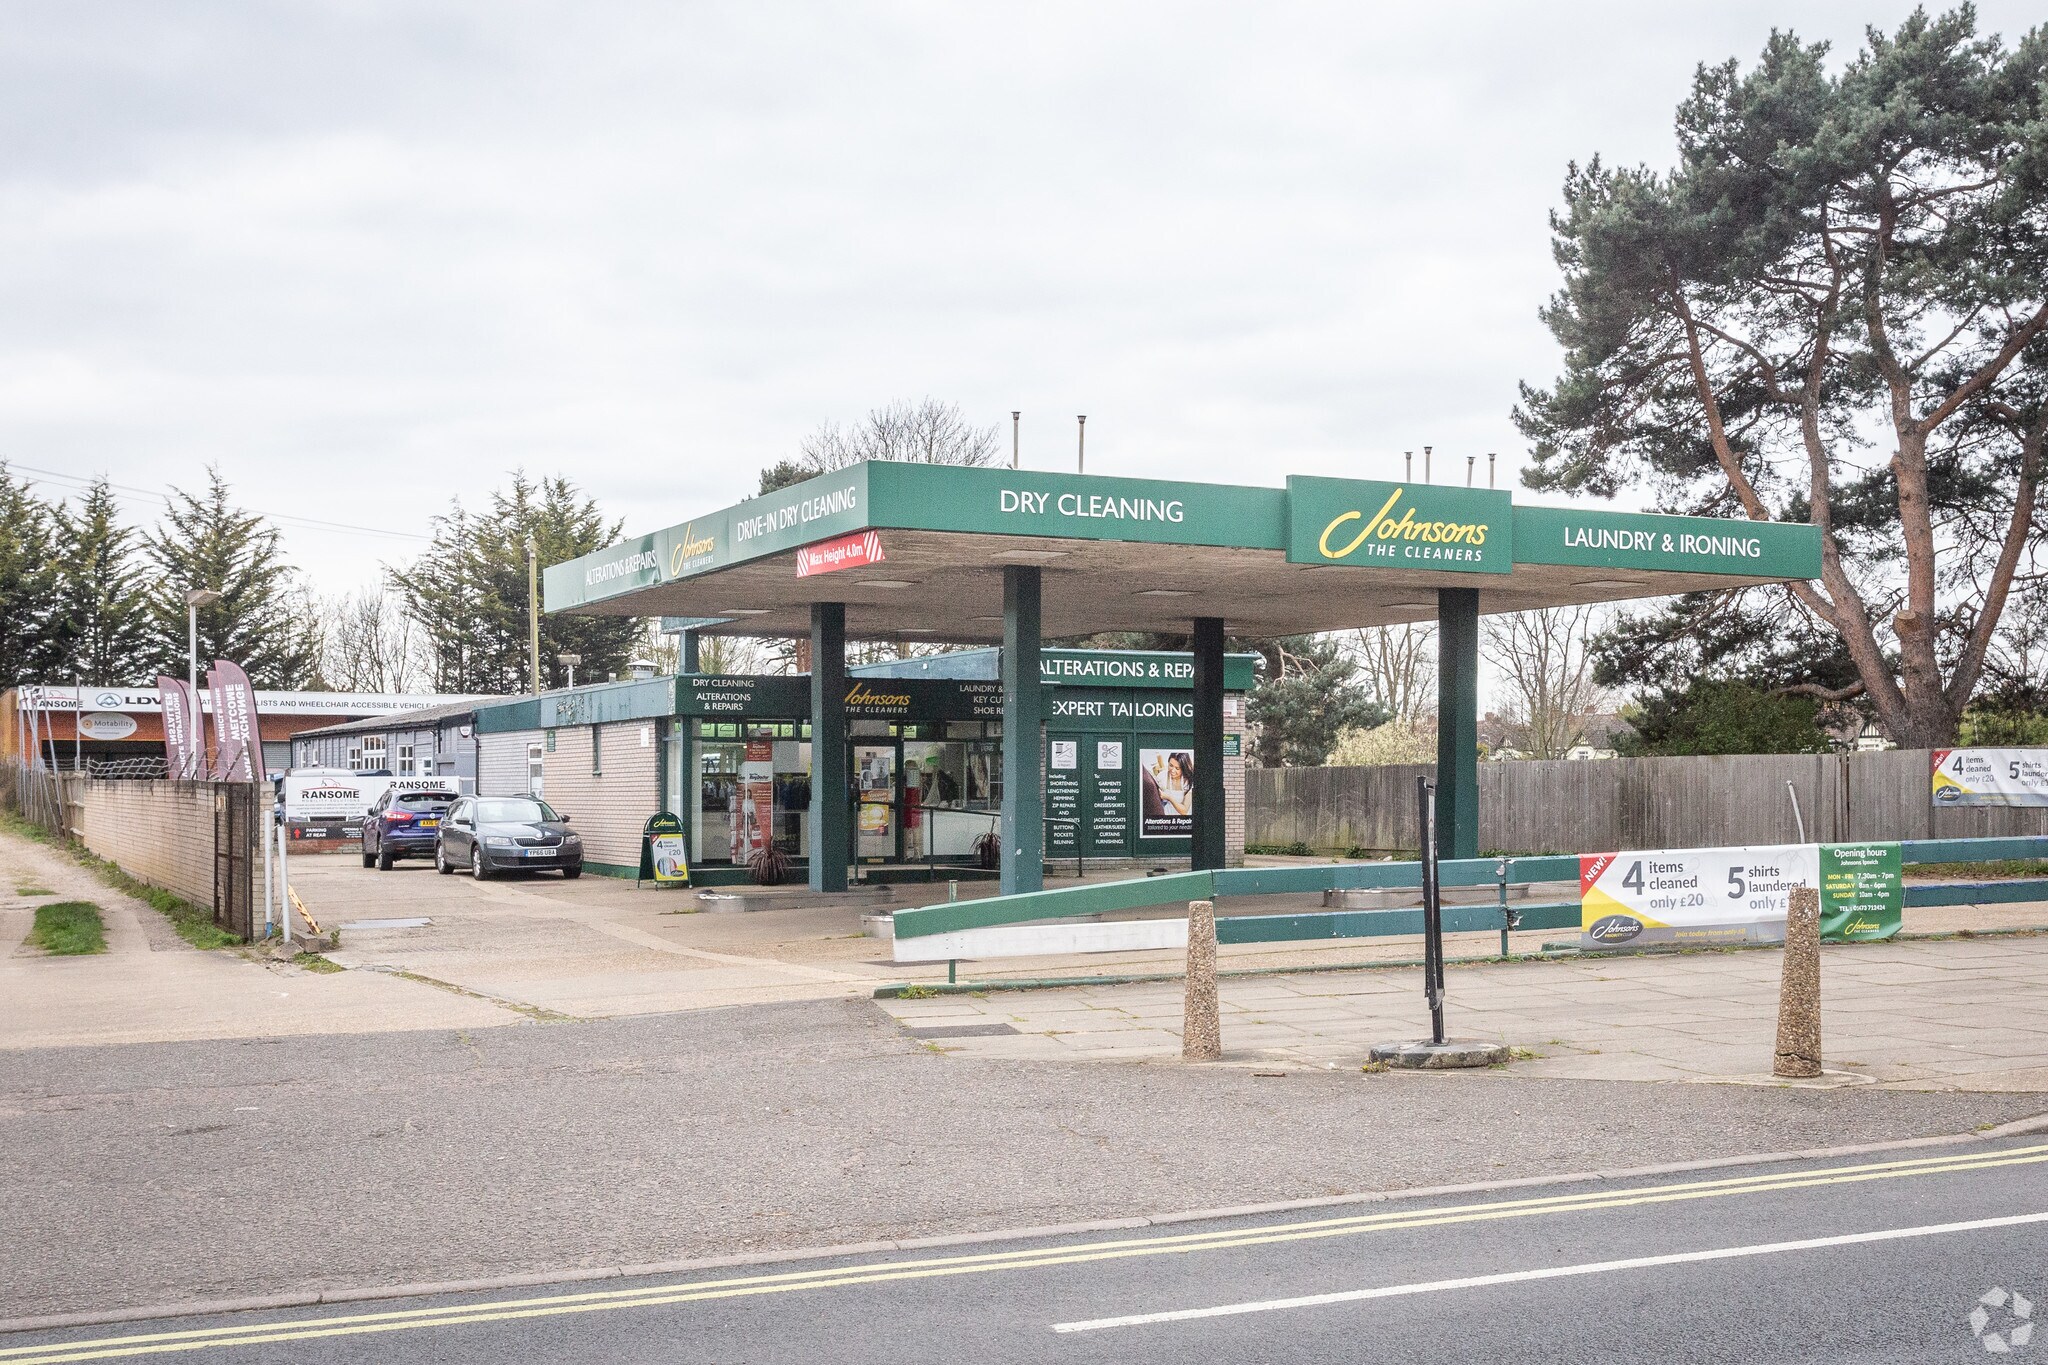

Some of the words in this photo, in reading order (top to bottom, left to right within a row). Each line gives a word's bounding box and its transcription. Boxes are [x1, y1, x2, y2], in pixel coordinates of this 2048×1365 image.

[737, 510, 777, 542] DRIVE-IN
[780, 504, 799, 530] DRY
[801, 486, 856, 523] CLEANING
[1000, 490, 1050, 514] DRY
[1058, 494, 1184, 523] CLEANING
[1318, 488, 1488, 559] Johnsons
[670, 522, 715, 577] Johnsons
[1564, 527, 1656, 551] LAUNDRY
[1662, 534, 1674, 553] &
[1680, 534, 1760, 558] IRONING
[809, 552, 823, 566] Max
[824, 547, 846, 565] Height
[846, 544, 864, 558] 4.0m
[1367, 544, 1396, 557] THE
[1404, 546, 1482, 562] CLEANERS
[586, 560, 624, 586] ALTERATIONS
[628, 550, 657, 574] REPAIRS
[683, 562, 692, 571] THE
[692, 554, 714, 568] CLEANERS
[1148, 662, 1160, 678] &
[692, 678, 710, 687] DRY
[712, 679, 754, 688] CLEANING
[960, 684, 996, 694] LAUNDRY
[38, 700, 84, 708] ANSOME
[125, 696, 162, 704] LDV
[298, 700, 350, 708] WHEELCHAIR
[696, 692, 752, 701] ALTERATIONS
[974, 696, 988, 704] KEY
[712, 702, 744, 710] REPAIRS
[865, 706, 908, 714] CLEANERS
[973, 706, 995, 714] SHOE
[1109, 702, 1194, 718] TAILORING
[94, 720, 134, 728] Motability
[1952, 756, 1964, 775] 4
[1966, 756, 1984, 764] items
[1966, 764, 1992, 772] cleaned
[2010, 761, 2020, 780] 5
[390, 781, 446, 789] RANSOME
[1966, 775, 1980, 784] only
[2022, 778, 2038, 788] only
[302, 790, 360, 799] RANSOME
[657, 841, 663, 849] 4
[1834, 848, 1865, 858] Opening
[1867, 848, 1887, 856] hours
[1584, 856, 1607, 882] NEW!
[1622, 860, 1646, 896] 4
[1649, 861, 1684, 874] items
[1650, 875, 1698, 890] cleaned
[1728, 866, 1746, 899] 5
[1748, 866, 1780, 878] shirts
[1749, 879, 1806, 892] laundered
[1650, 896, 1676, 910] only
[1680, 894, 1704, 907] £20
[1750, 896, 1776, 911] only
[1592, 919, 1640, 939] Johnsons
[1845, 918, 1880, 934] Johnsons
[1689, 930, 1706, 938] today
